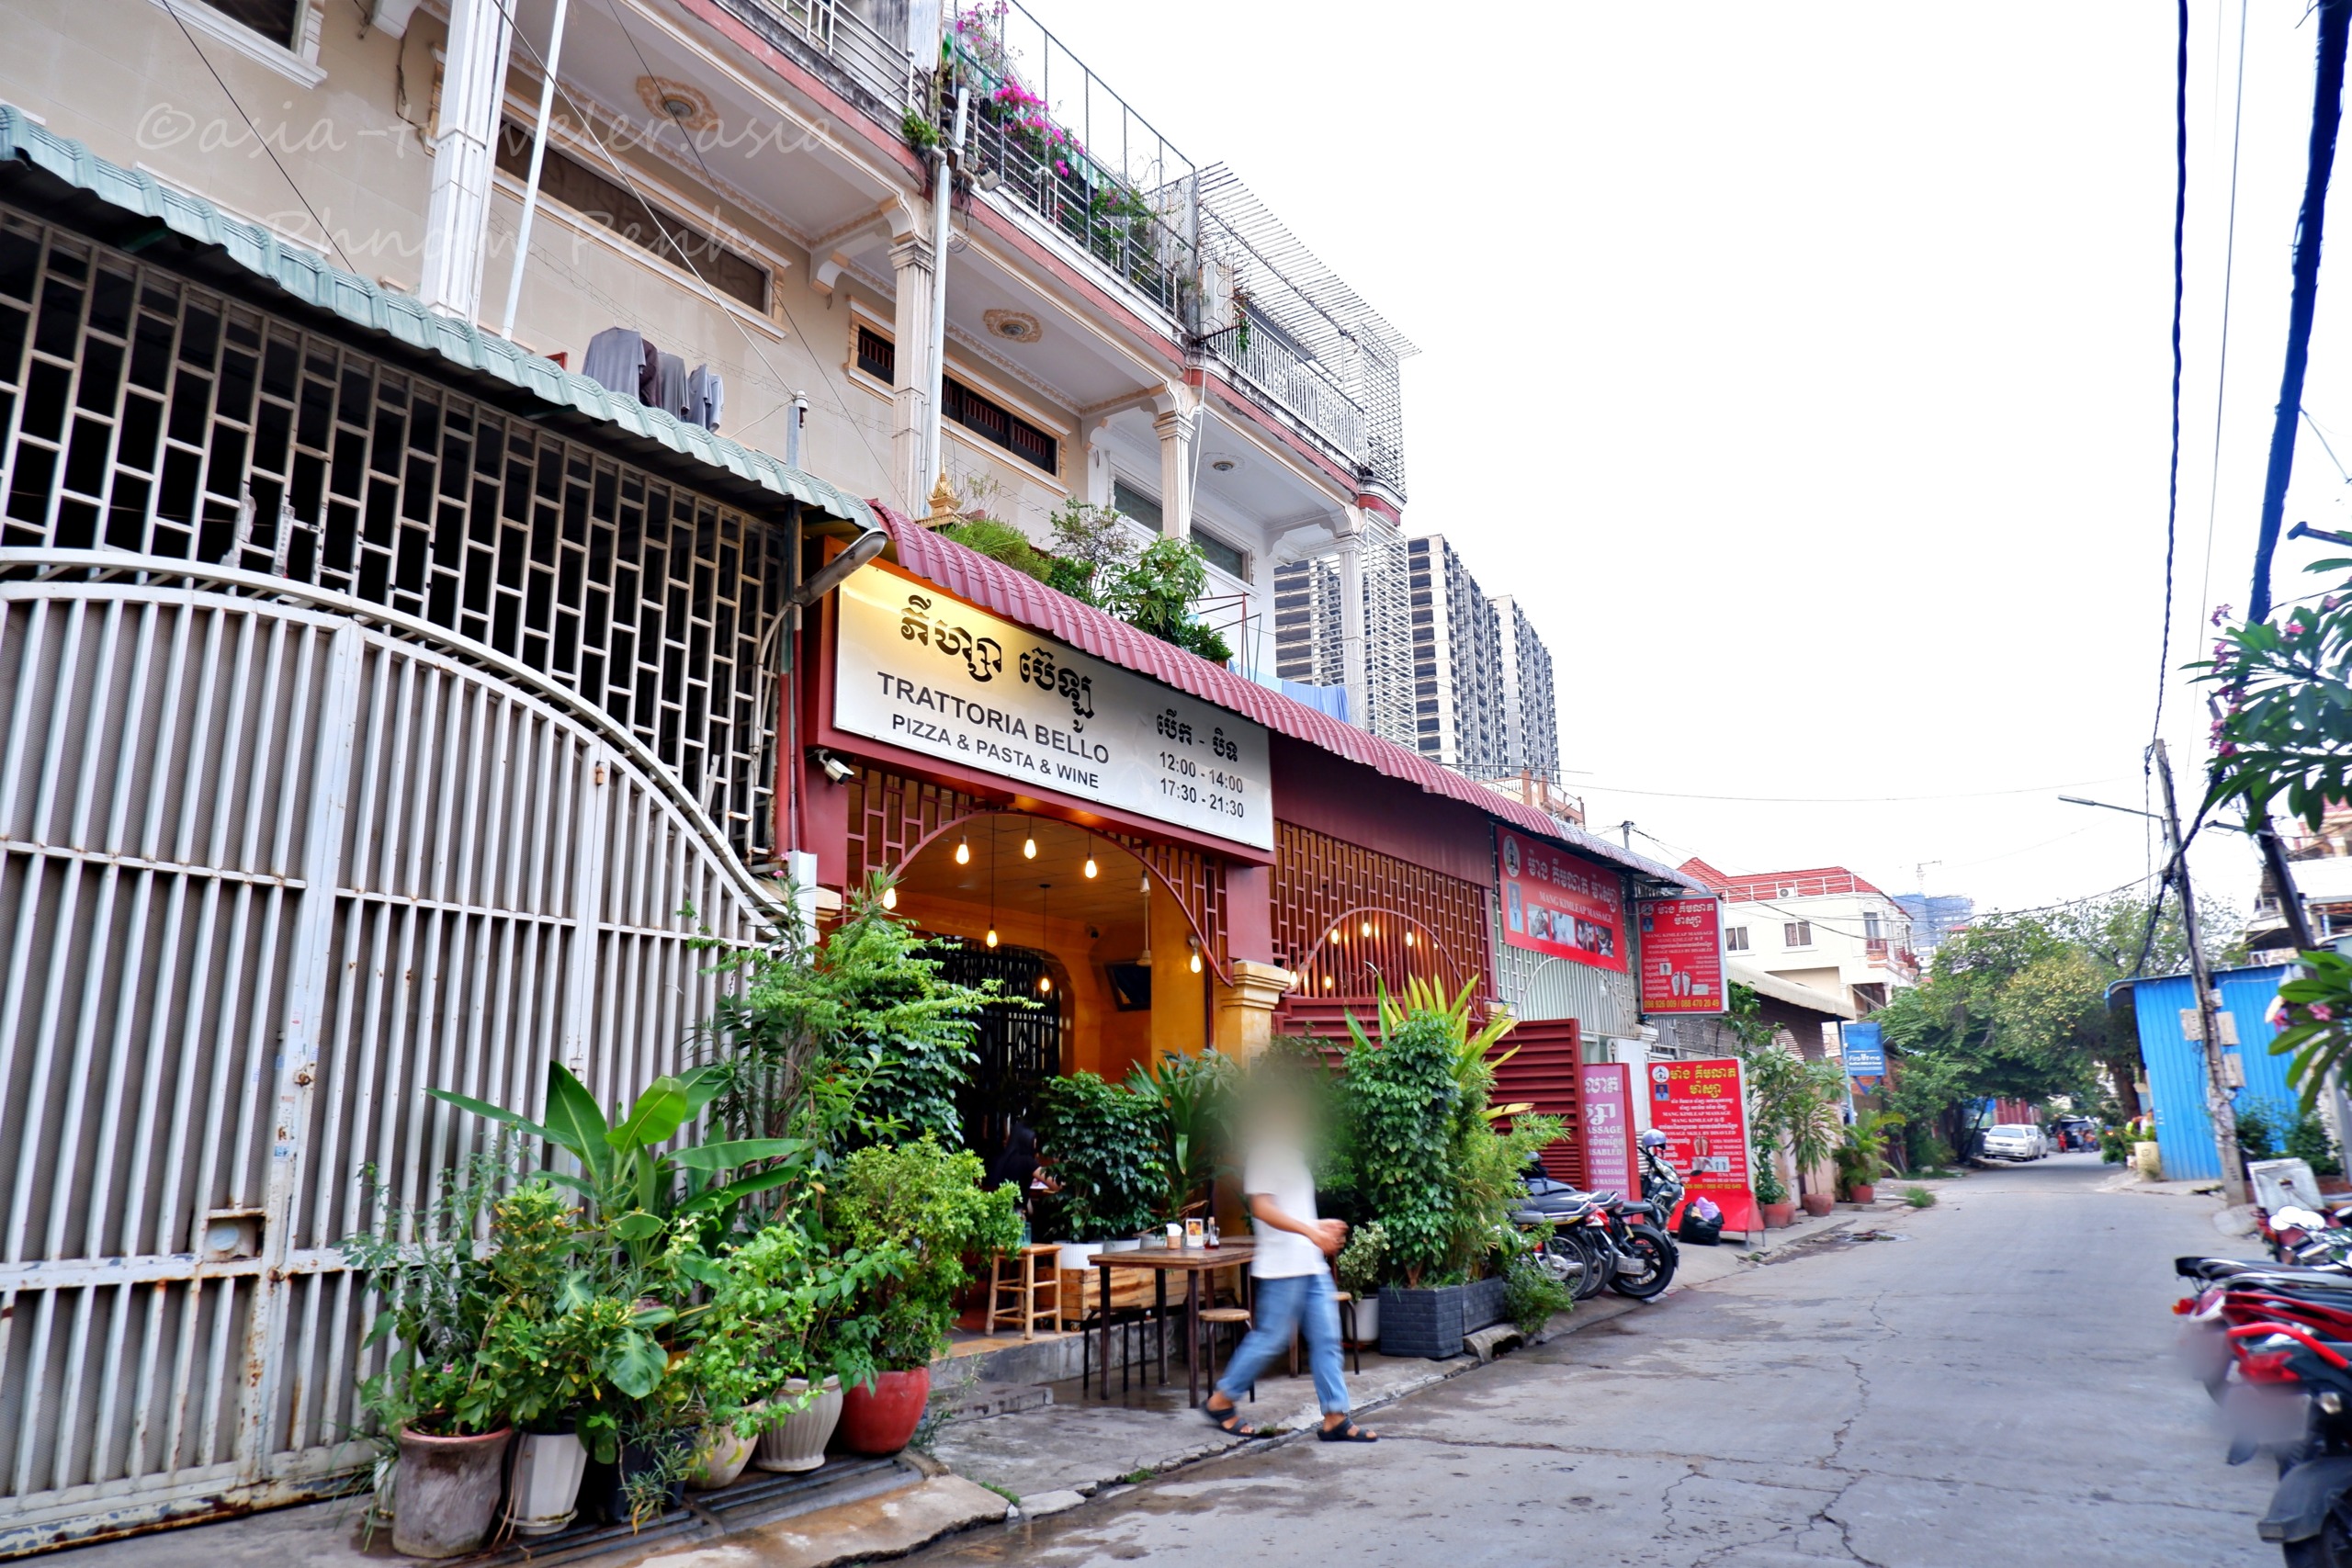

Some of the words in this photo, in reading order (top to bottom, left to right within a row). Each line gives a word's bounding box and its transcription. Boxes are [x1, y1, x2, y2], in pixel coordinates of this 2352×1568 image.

[877, 671, 1028, 739] TRATTORIA
[1035, 724, 1109, 763] BELLO
[892, 714, 951, 746] PIZZA
[957, 734, 969, 750] &
[977, 739, 1035, 771] PASTA
[1040, 759, 1051, 775] &
[1057, 763, 1099, 788] WINE
[1159, 751, 1196, 777] 12:00
[1209, 769, 1243, 793] 14:00
[1160, 778, 1197, 803] 17:30
[1209, 794, 1244, 818] 21:30
[1539, 891, 1559, 907] MANG
[1559, 898, 1587, 915] KIMLEAP
[1587, 907, 1613, 923] MASSAGE
